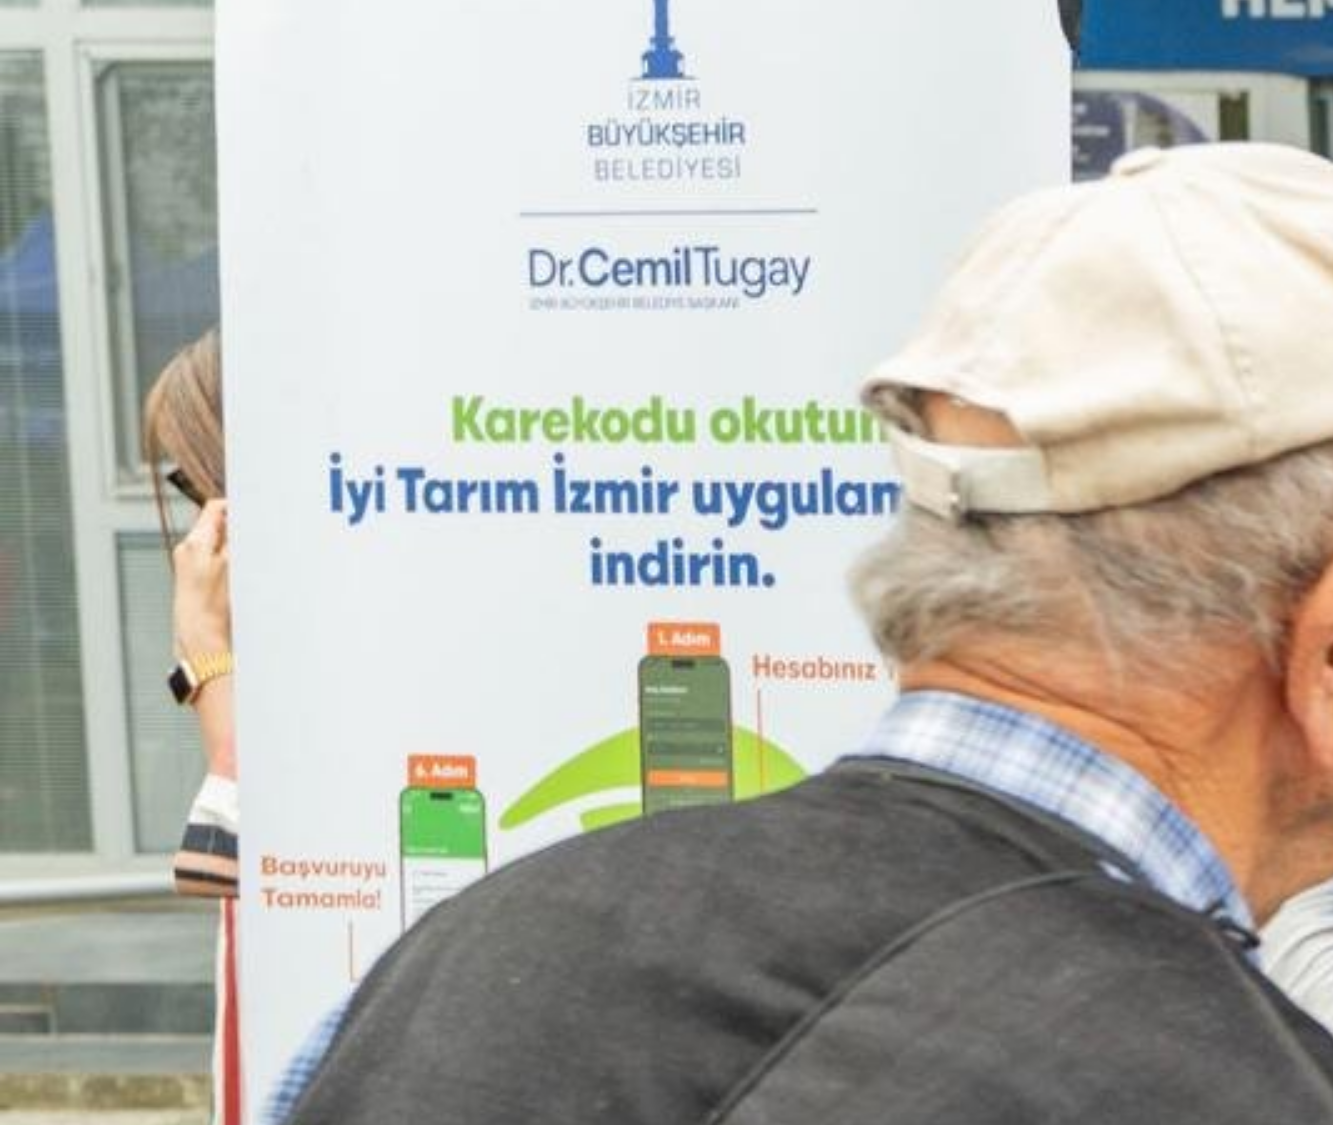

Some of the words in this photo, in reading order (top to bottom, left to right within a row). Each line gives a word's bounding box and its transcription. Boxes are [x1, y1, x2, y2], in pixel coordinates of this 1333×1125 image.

[627, 83, 701, 111] İZMİR
[587, 116, 746, 148] BÜYÜKŞEHİR
[594, 153, 743, 181] BELEDİYESİ
[452, 396, 696, 442] Karekodu
[330, 452, 385, 525] İyi
[396, 468, 539, 513] Tarım
[554, 452, 679, 513] İzmir
[590, 537, 775, 587] indirin.
[753, 654, 877, 681] Hesabınız
[260, 855, 388, 882] Başvuruyu
[262, 887, 382, 910] Tamamla!
